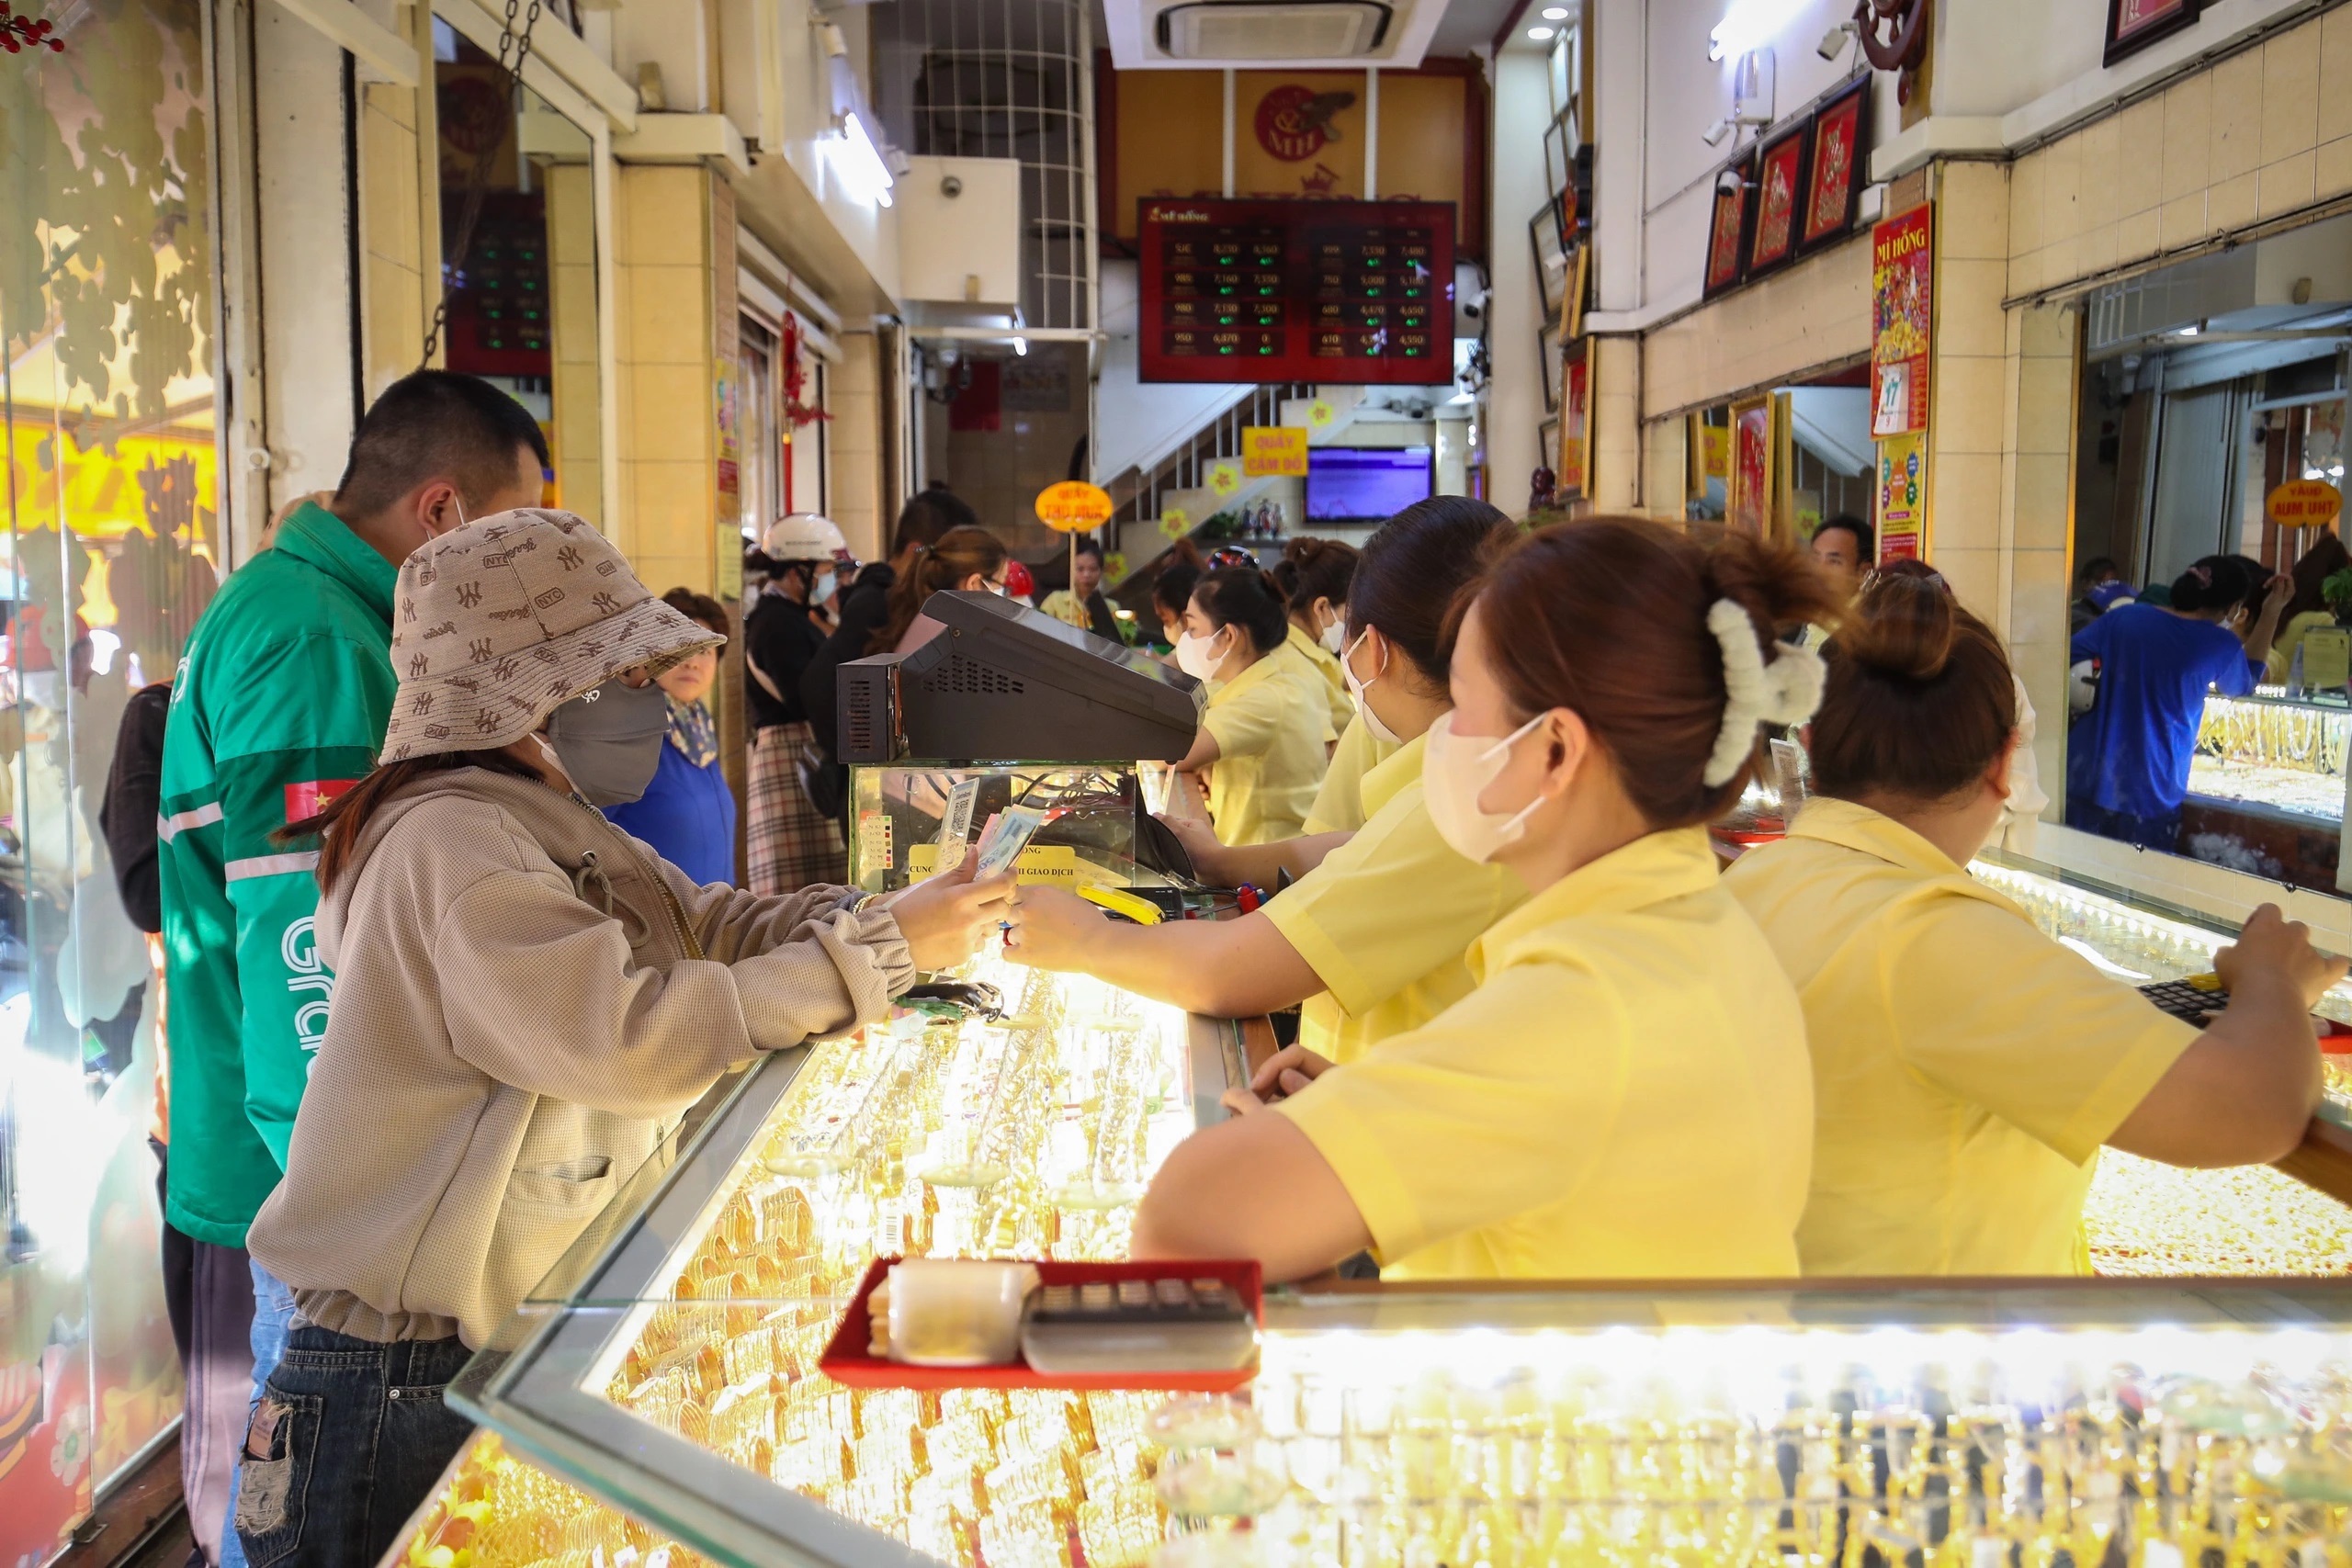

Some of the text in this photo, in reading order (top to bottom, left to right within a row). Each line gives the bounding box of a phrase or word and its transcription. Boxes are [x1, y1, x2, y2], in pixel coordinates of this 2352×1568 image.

[1886, 381, 1899, 407] 17
[537, 590, 562, 608] NYC
[1051, 868, 1074, 877] DỊCH
